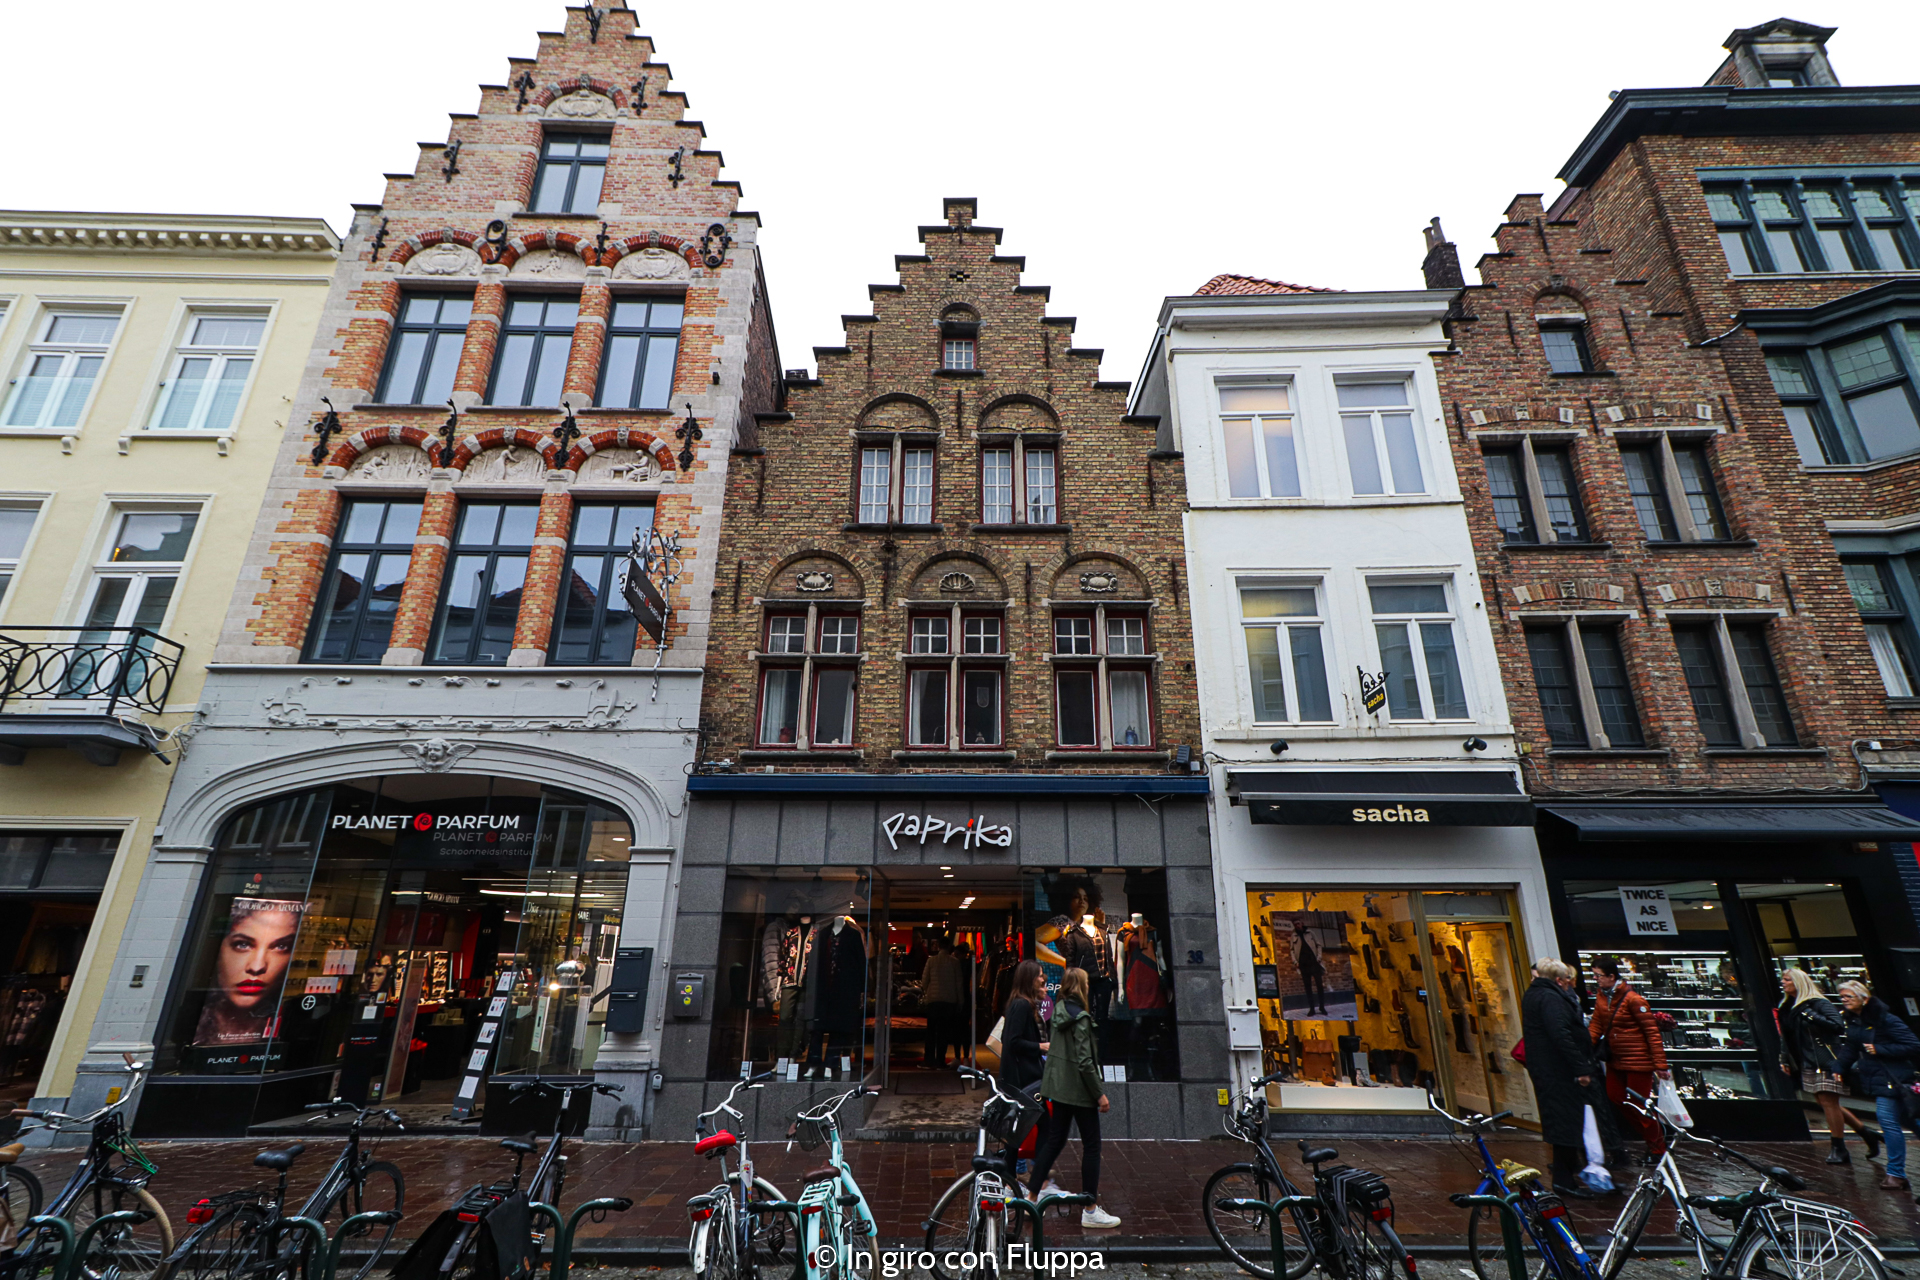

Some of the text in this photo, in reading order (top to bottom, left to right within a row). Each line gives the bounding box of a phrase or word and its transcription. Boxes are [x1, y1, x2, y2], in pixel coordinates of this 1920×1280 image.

[1367, 693, 1384, 709] sacha
[1352, 804, 1430, 822] sacha
[331, 815, 520, 829] PLANET PARFUM
[433, 832, 553, 843] PLANET PARFUM
[439, 847, 540, 856] Schoonheidsinstituut
[1622, 889, 1666, 900] TWICE
[238, 901, 275, 910] GIORGIO
[1640, 905, 1659, 915] AS
[1636, 921, 1669, 931] NICE
[1187, 950, 1204, 964] 38
[249, 1054, 281, 1062] PARFUM
